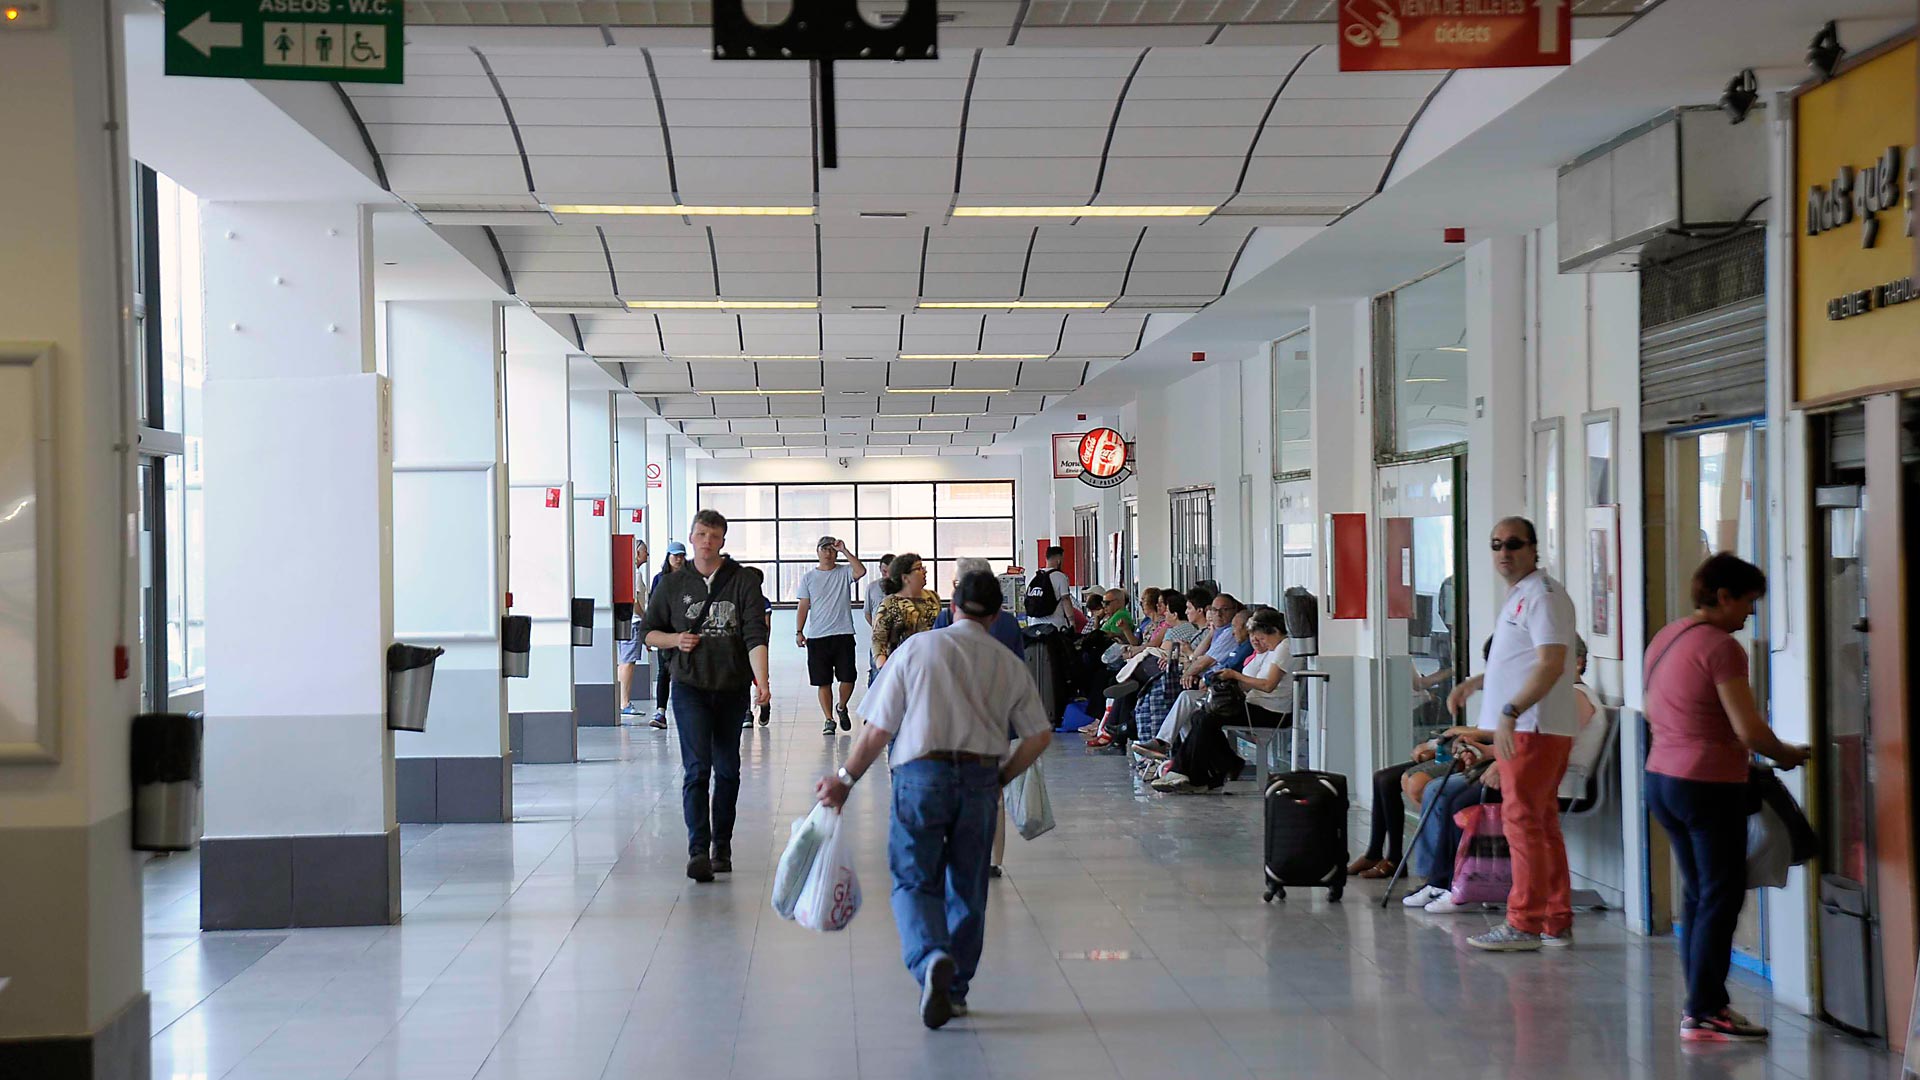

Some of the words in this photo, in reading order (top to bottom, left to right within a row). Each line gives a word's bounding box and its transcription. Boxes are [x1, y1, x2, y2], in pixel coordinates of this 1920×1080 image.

[259, 0, 331, 13] ASEOS
[350, 0, 393, 14] W.C.
[1400, 0, 1440, 16] VENTA
[1444, 0, 1462, 15] DE
[1465, 0, 1526, 15] BILLETES
[1435, 22, 1491, 43] tickets
